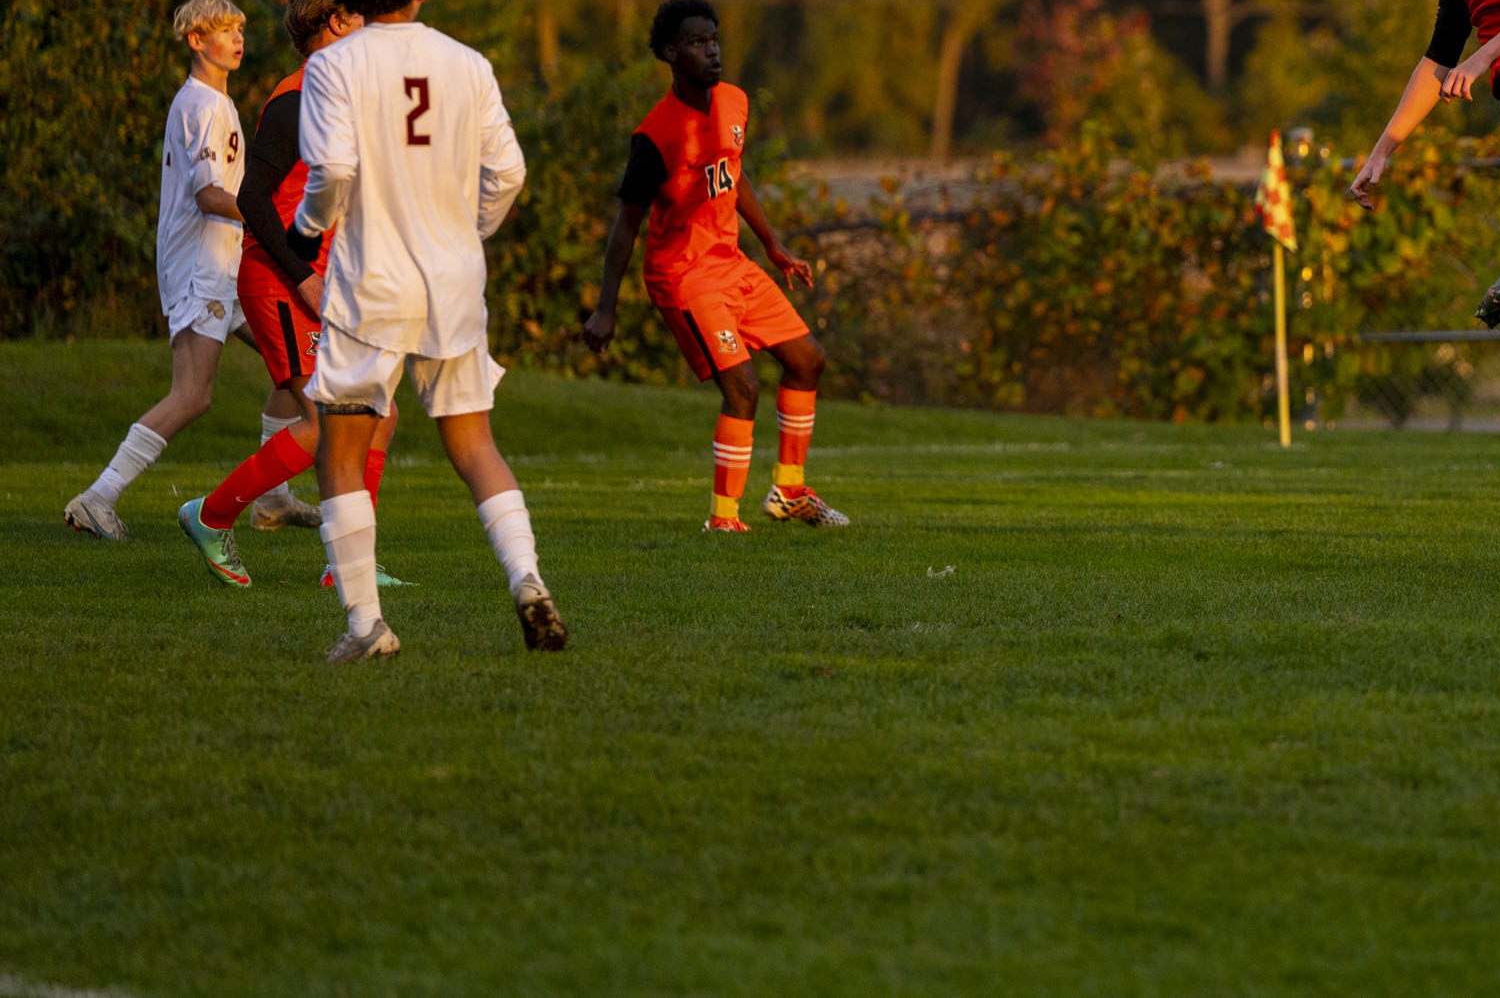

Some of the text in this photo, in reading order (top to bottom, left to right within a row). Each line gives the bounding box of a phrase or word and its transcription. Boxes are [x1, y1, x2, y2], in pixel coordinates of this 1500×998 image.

[403, 76, 430, 145] 2
[227, 131, 239, 164] 9
[705, 157, 734, 199] 14
